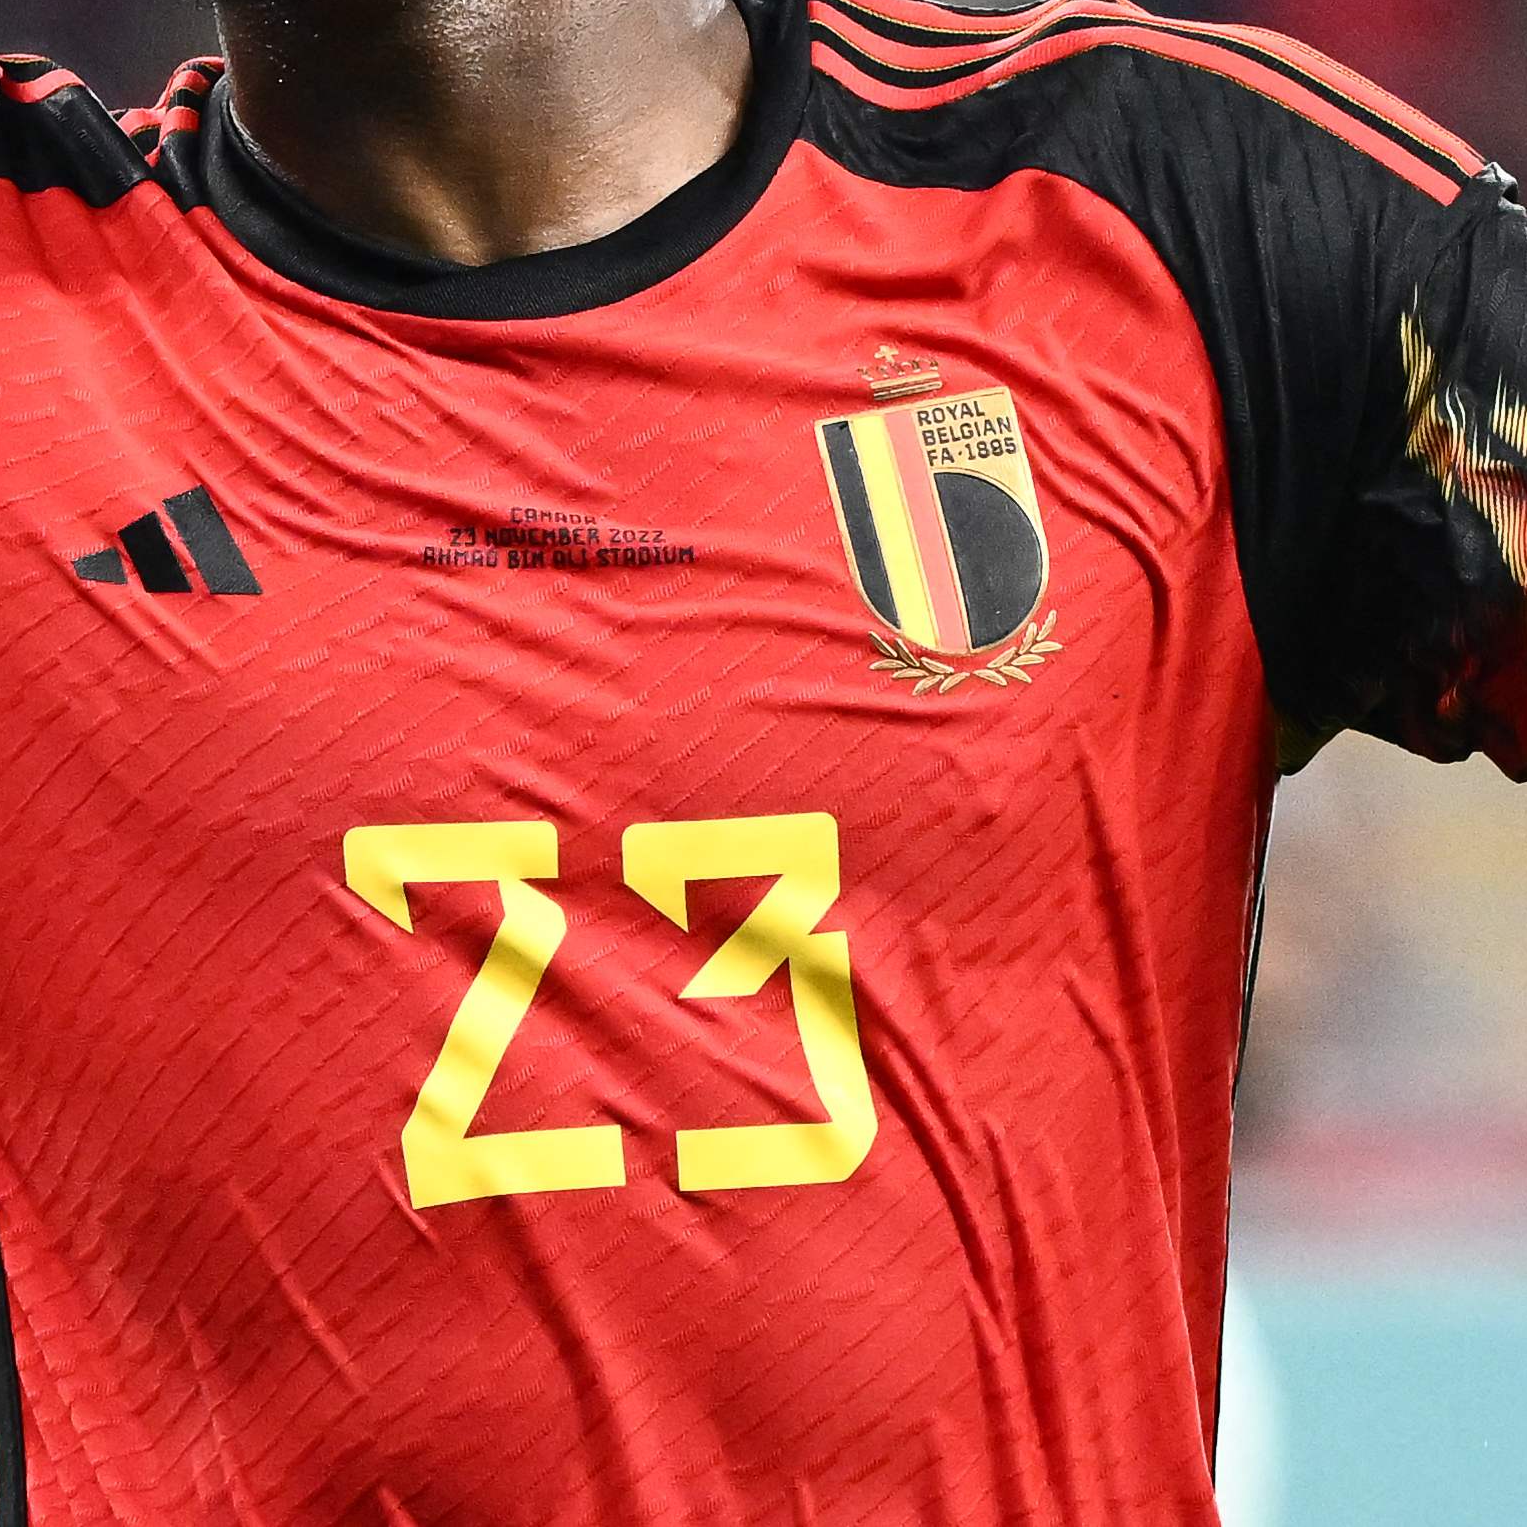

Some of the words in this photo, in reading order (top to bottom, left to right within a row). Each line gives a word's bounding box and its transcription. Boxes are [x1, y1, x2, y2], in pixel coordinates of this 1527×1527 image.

[917, 400, 985, 427] ROYAL
[922, 416, 1012, 446] BELGIAN
[510, 507, 597, 525] CANADA
[449, 527, 476, 547] 23
[485, 527, 600, 547] NOVEMBER
[609, 528, 665, 544] 2022
[423, 546, 497, 568] AHMAD
[507, 550, 544, 569] BIN
[595, 546, 695, 567] STADIUM
[343, 812, 878, 1210] 23
